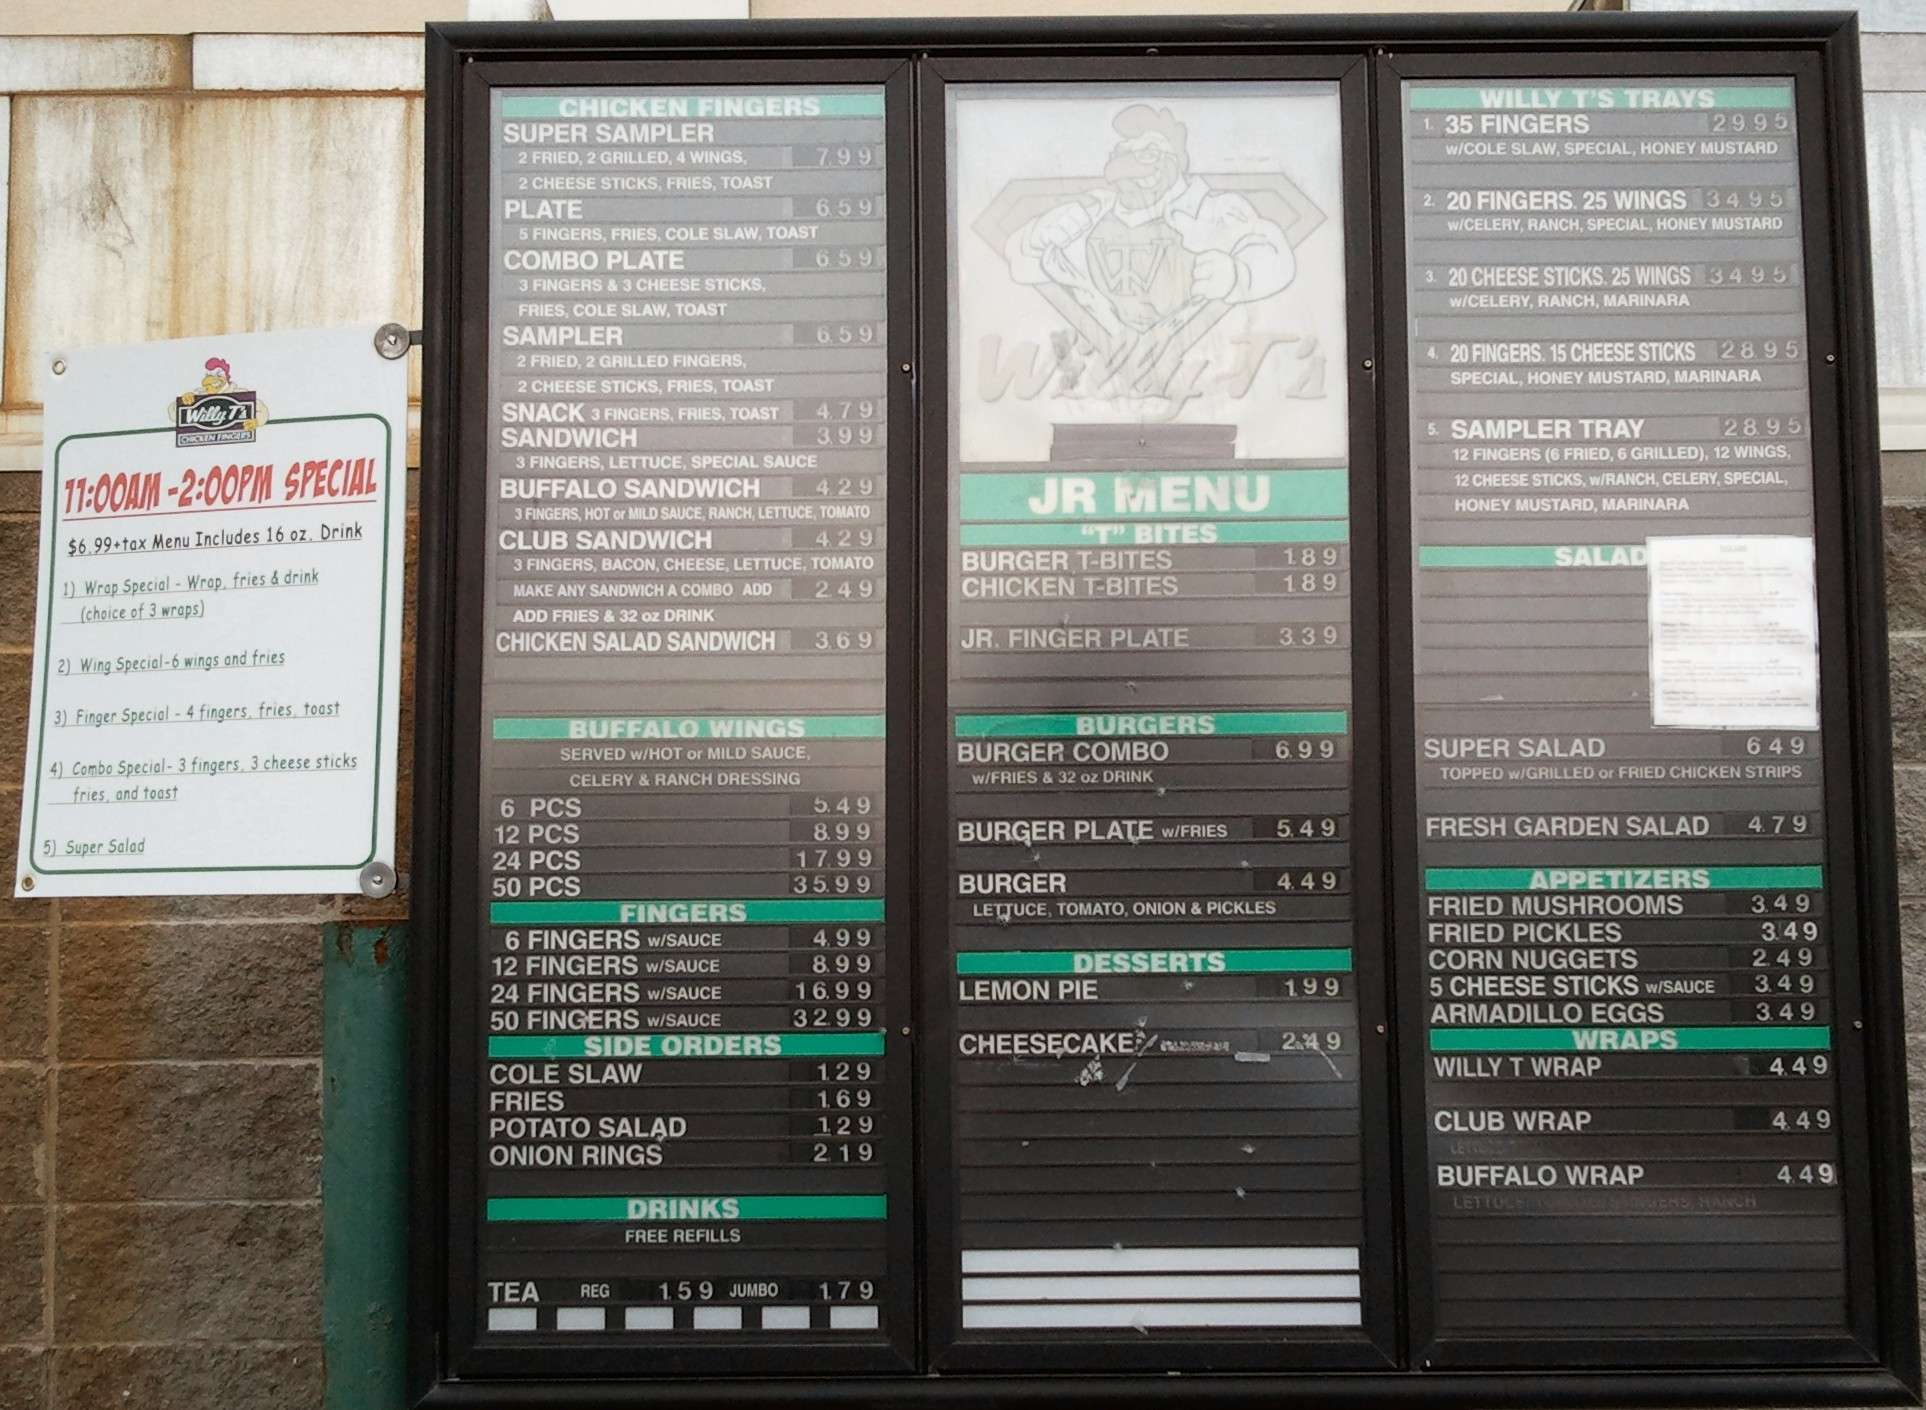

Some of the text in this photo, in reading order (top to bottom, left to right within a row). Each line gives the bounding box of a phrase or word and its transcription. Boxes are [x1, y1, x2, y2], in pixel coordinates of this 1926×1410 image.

[559, 96, 821, 117] CHICKEN FINGERS
[1480, 88, 1715, 108] WILLY T'S TRAYS
[504, 123, 715, 143] SUPER SAMPLER
[1445, 114, 1590, 134] 35 FINGERS
[518, 152, 528, 164] 2
[532, 151, 582, 166] FRIED,
[587, 152, 596, 164] 2
[599, 151, 672, 165] GRILLED,
[676, 151, 685, 164] 4
[689, 151, 747, 165] WINGS,
[1446, 141, 1778, 157] w/COLE SLAW, SPECIAL, HONEY MUSTARD
[505, 200, 583, 219] PLATE
[504, 250, 684, 270] COMBO PLATE
[503, 326, 623, 346] SAMPLER
[186, 405, 228, 427] Willy
[502, 403, 779, 422] SNACK 3 FINGERS, FRIES, TOAST
[501, 428, 637, 448] SANDWICH
[1451, 418, 1645, 440] SAMPLER TRAY
[285, 457, 377, 500] SPECIAL
[500, 478, 760, 498] BUFFALO SANDWICH
[1028, 476, 1272, 514] JR MENU
[1455, 498, 1689, 513] HONEY MUSTARD, MARINARA
[152, 534, 190, 549] Menu
[196, 528, 260, 546] Includes
[267, 527, 284, 543] 16
[321, 523, 363, 539] Drink
[499, 530, 712, 550] CLUB SANDWICH
[80, 600, 205, 621] (choice of 3 wraps)
[496, 631, 776, 652] CHICKEN SALAD SANDWICH
[569, 719, 805, 739] BUFFALO WINGS
[1076, 716, 1215, 734] BURGERS
[560, 746, 811, 761] SERVED w/HOT or MILD SAUCE,
[957, 742, 1064, 762] BURGER
[1073, 741, 1169, 761] COMBO
[1424, 738, 1606, 759] SUPER SALAD
[72, 762, 113, 776] Combo
[178, 759, 186, 772] 3
[251, 756, 259, 769] 3
[263, 755, 310, 769] cheese
[316, 752, 358, 768] sticks
[1440, 765, 1802, 780] TOPPED w/GRILLED or FRIED CHICKEN STRIPS
[570, 772, 800, 787] CELERY & RANCH DRESSING
[972, 770, 1154, 784] w/FRIES & 32 oz DRINK
[958, 820, 1228, 842] BURGER PLATE w/FRIES
[1426, 816, 1710, 837] FRESH GARDEN SALAD
[65, 840, 104, 857] Super
[108, 838, 145, 854] Salad
[492, 877, 521, 897] 50
[529, 877, 581, 896] PCS
[1529, 869, 1710, 889] APPETIZERS
[620, 903, 747, 923] FINGERS
[973, 901, 1276, 917] LETTUCE, TOMATO, ONION & PICKLES
[1428, 896, 1504, 915] FRIED
[1512, 895, 1683, 915] MUSHROOMS
[1073, 953, 1227, 973] DESSERTS
[959, 980, 1098, 1001] LEMON PIE
[490, 1011, 519, 1030] 50
[528, 1010, 640, 1030] FINGERS
[647, 1013, 721, 1027] w/SAUCE
[1431, 1003, 1664, 1024] ARMADILLO EGGS
[584, 1036, 782, 1056] SIDE ORDERS
[1572, 1030, 1678, 1050] WRAPS
[490, 1065, 560, 1084] COLE
[568, 1064, 642, 1084] SLAW
[490, 1117, 687, 1138] POTATO SALAD
[1434, 1111, 1505, 1131] CLUB
[1513, 1110, 1592, 1130] WRAP
[490, 1146, 574, 1166] ONION
[582, 1145, 663, 1165] RINGS
[1437, 1164, 1644, 1186] BUFFALO WRAP
[627, 1199, 740, 1219] DRINKS
[625, 1229, 741, 1243] FREE REFILLS
[488, 1282, 539, 1302] TEA
[581, 1284, 610, 1298] REG
[729, 1283, 779, 1298] JUMBO
